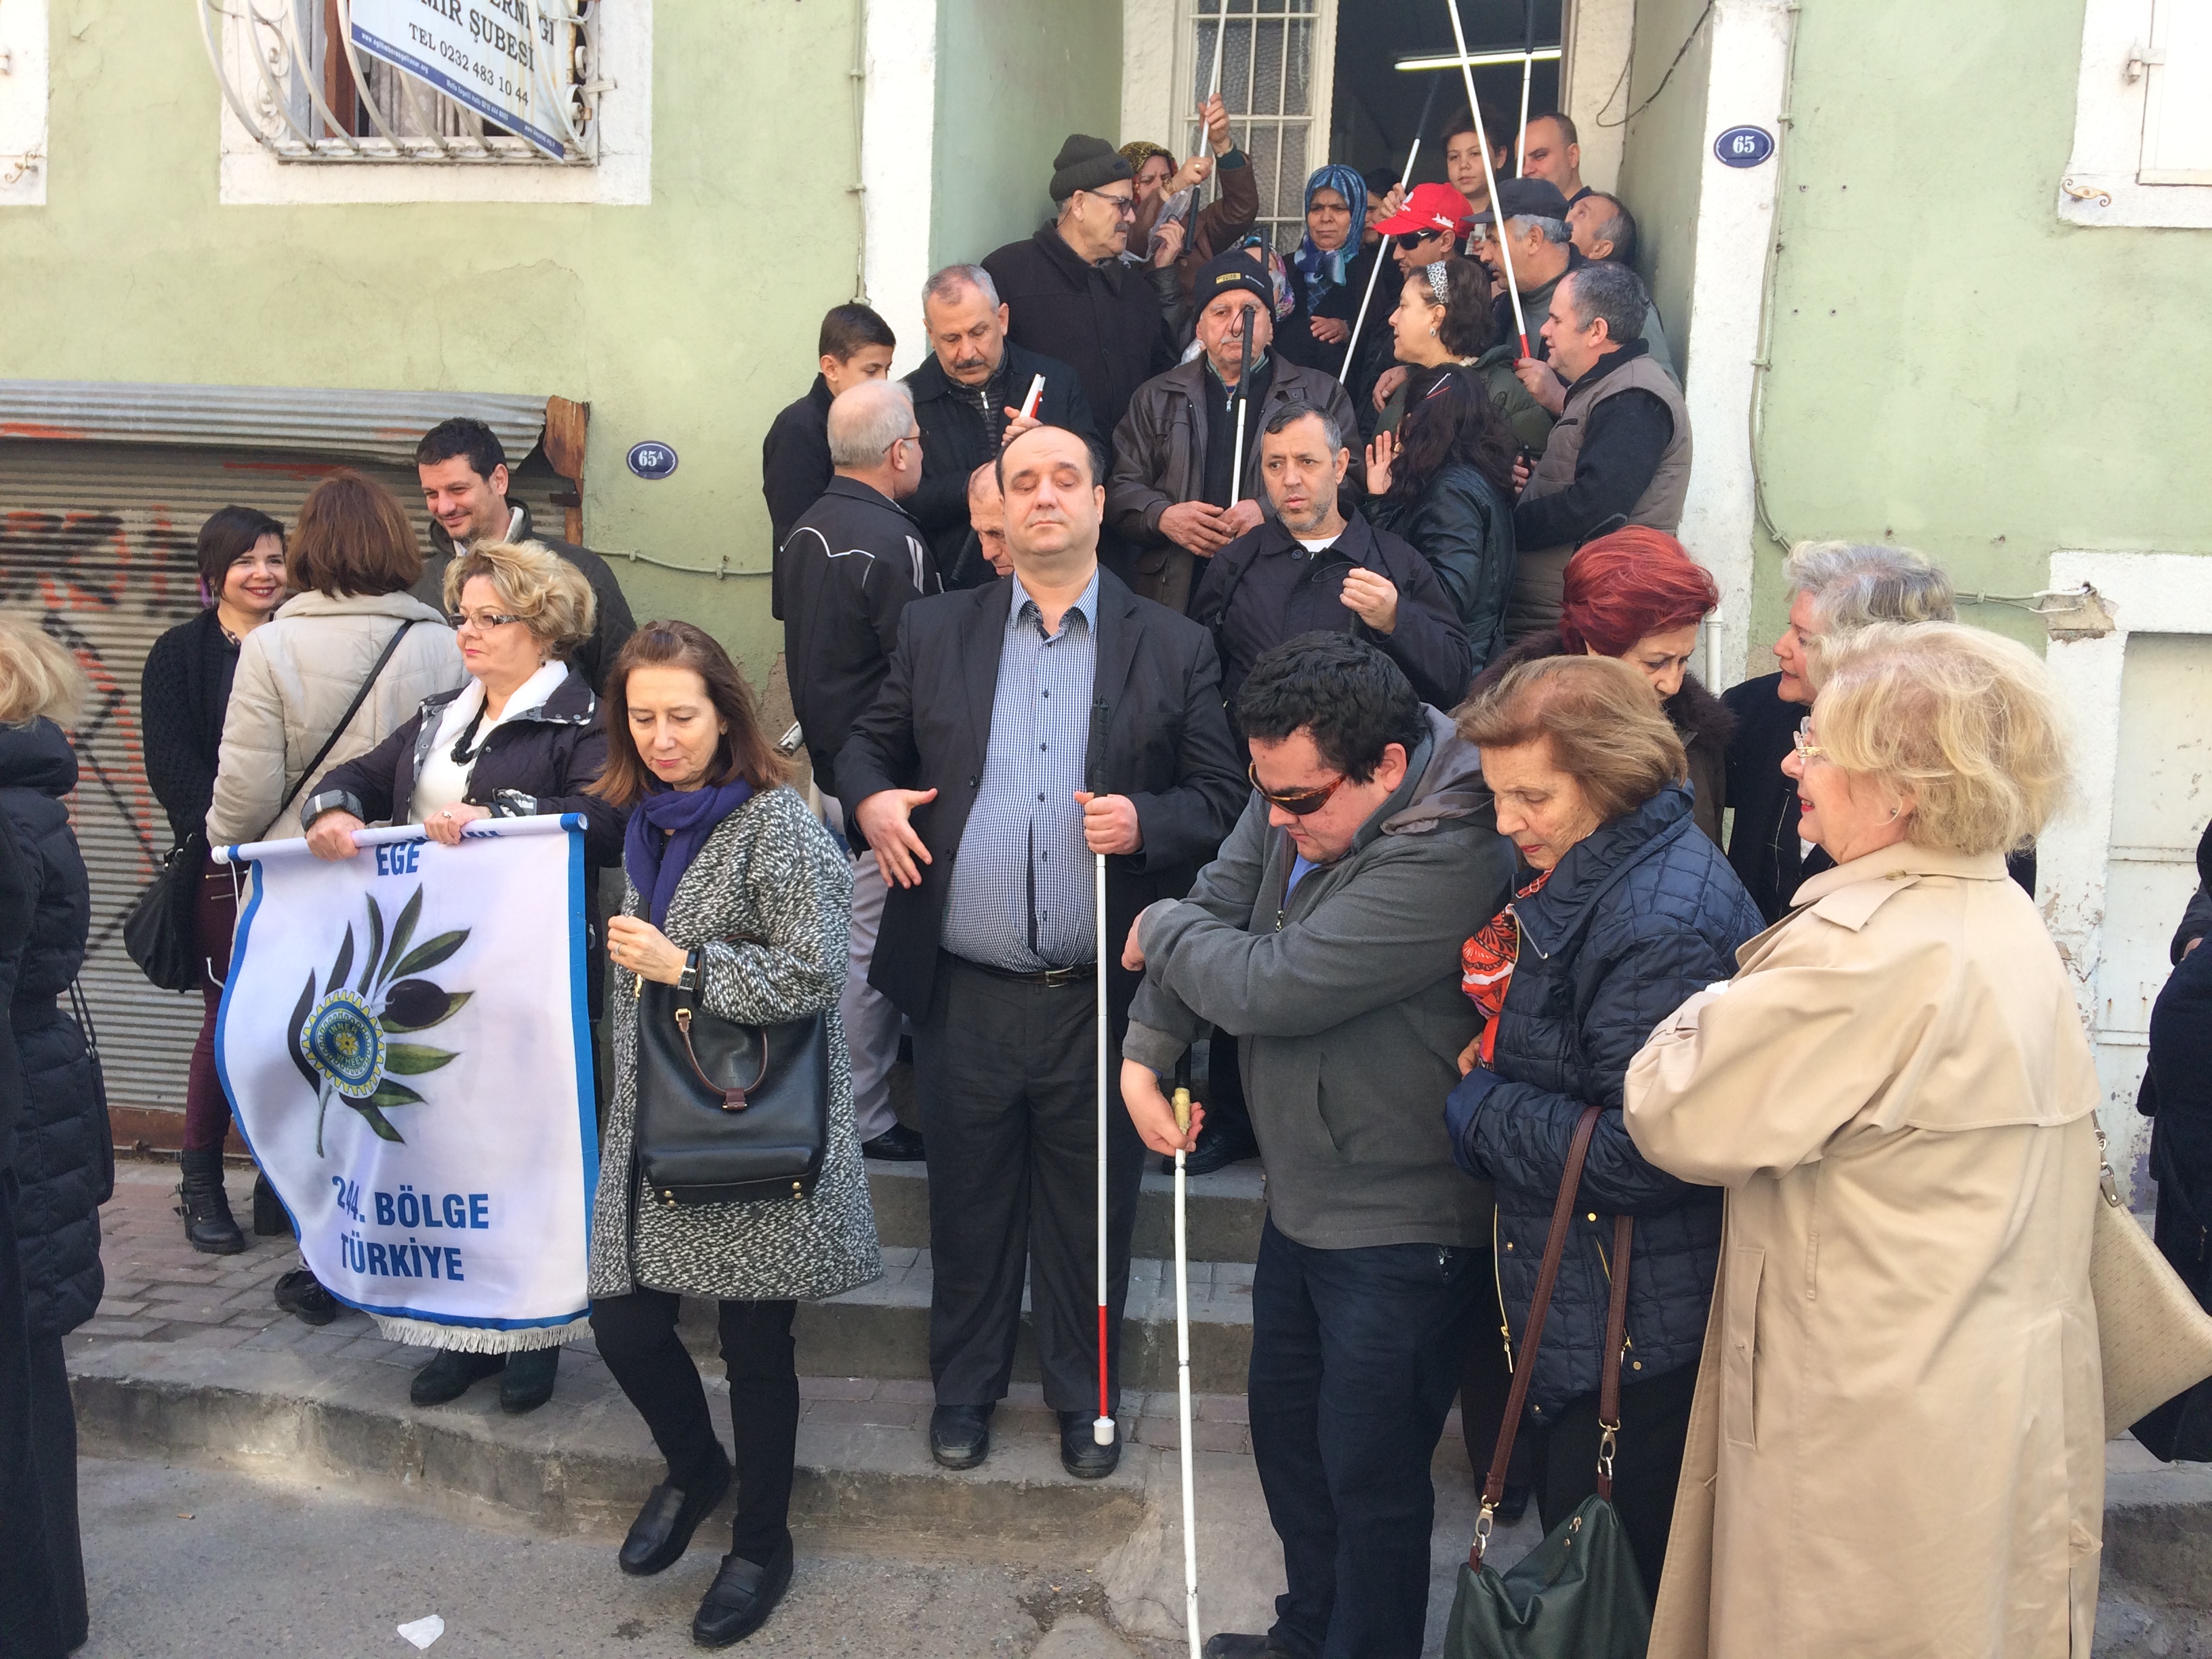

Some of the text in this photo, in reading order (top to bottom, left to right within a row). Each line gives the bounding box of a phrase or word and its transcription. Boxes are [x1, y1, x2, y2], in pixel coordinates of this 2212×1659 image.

[470, 8, 534, 72] ŞUBESİ
[409, 22, 436, 51] TEL
[440, 41, 468, 72] 0232
[472, 62, 494, 85] 483
[499, 77, 512, 96] 10
[516, 87, 529, 106] 44
[1733, 136, 1755, 153] 65
[638, 450, 663, 466] 65A
[376, 841, 425, 876] EGE
[329, 1023, 358, 1035] INNER
[337, 1052, 364, 1066] WHEEL
[332, 1176, 489, 1229] 244. BÖLGE
[341, 1230, 464, 1281] TÜRKİYE
